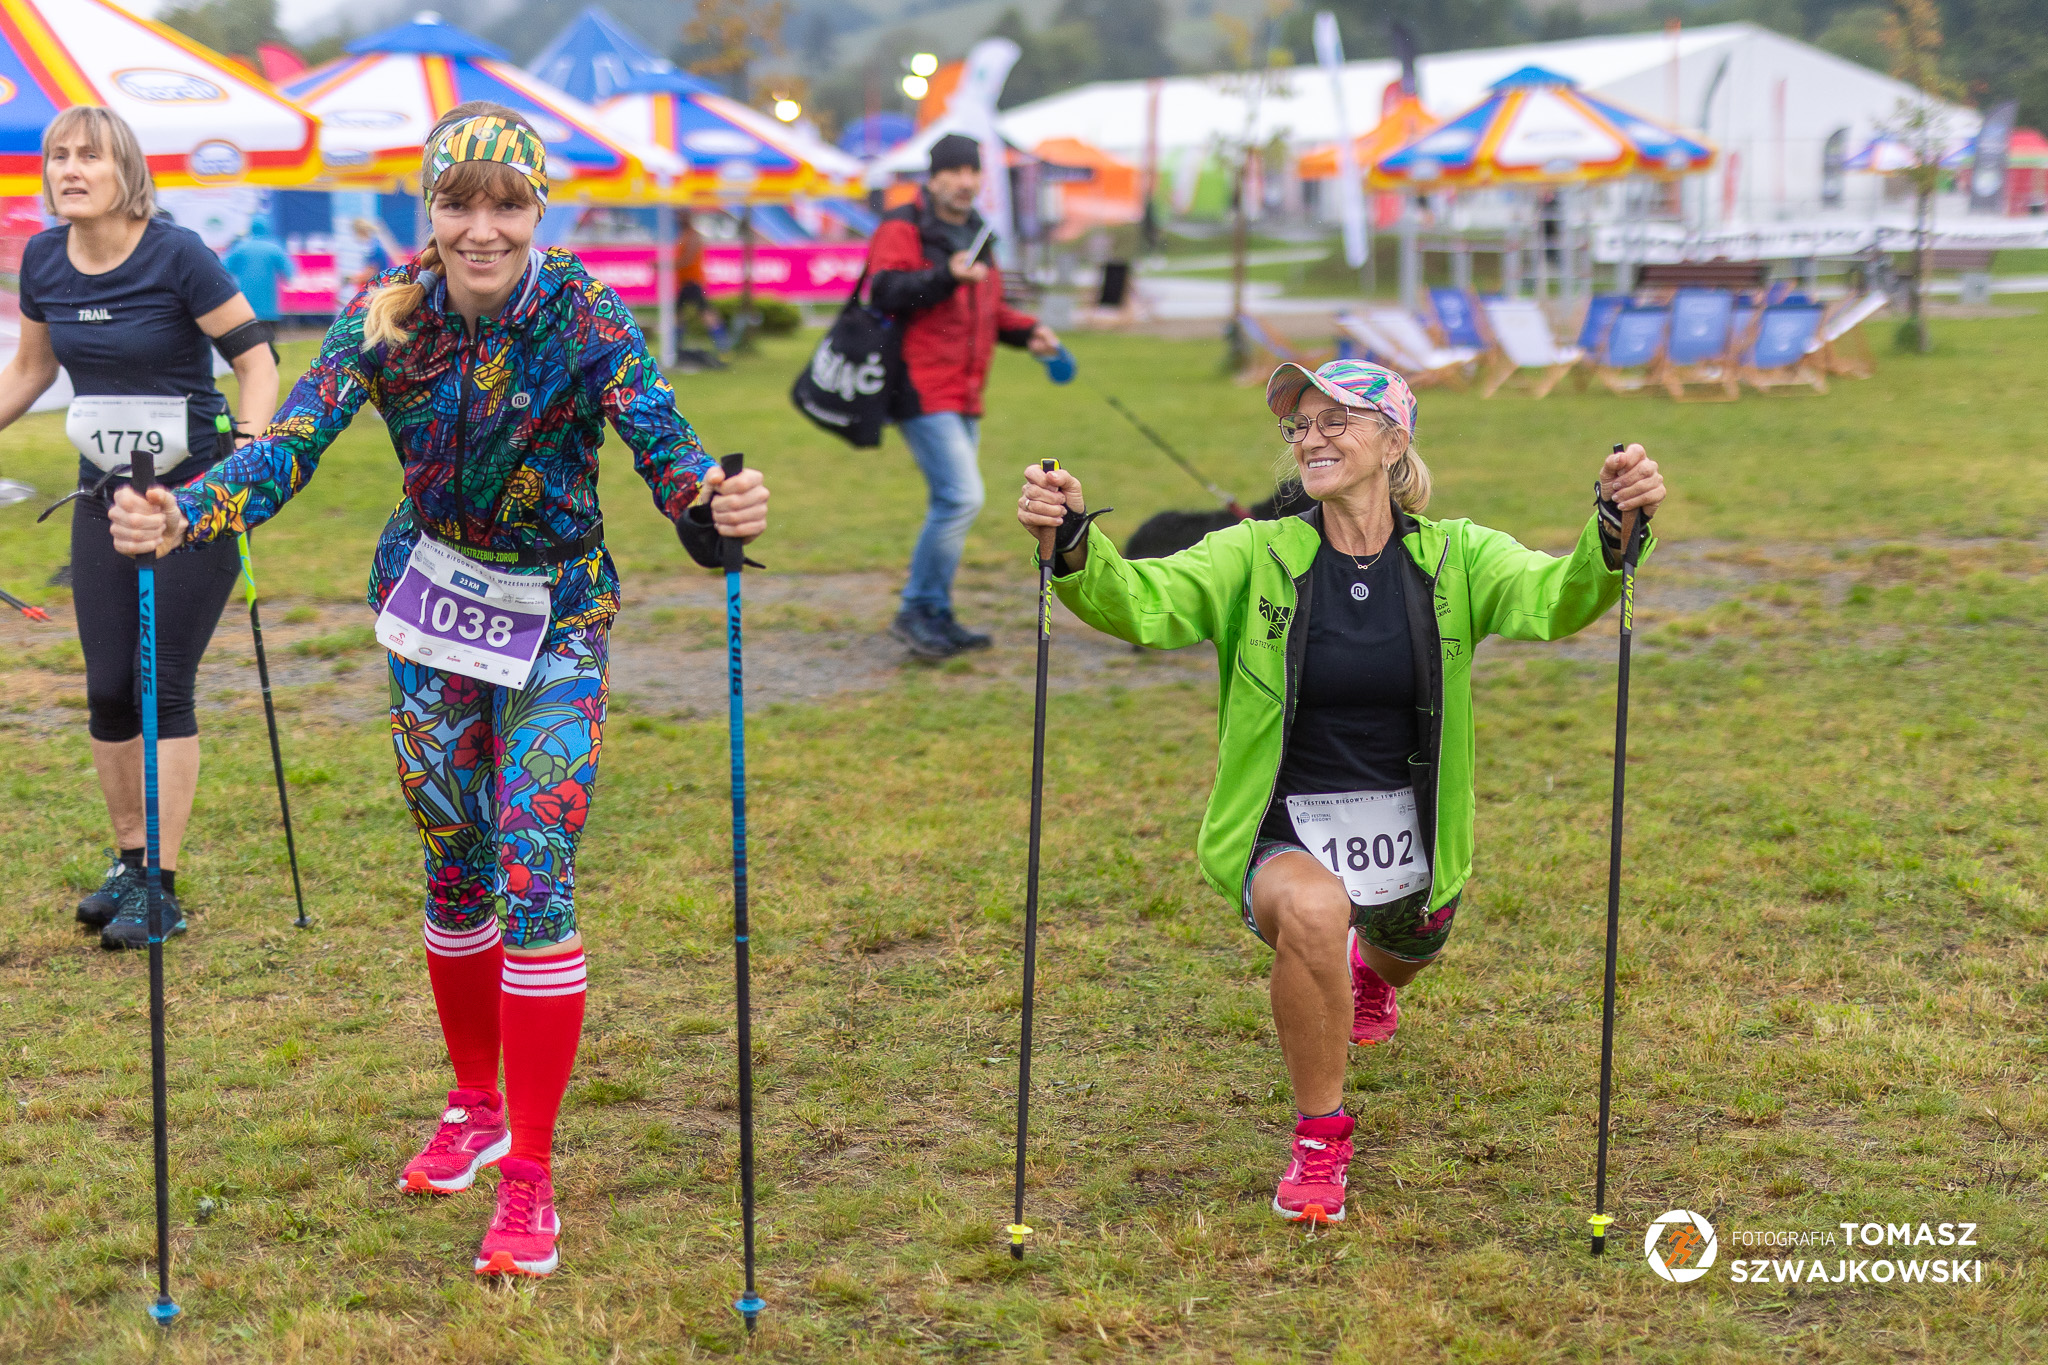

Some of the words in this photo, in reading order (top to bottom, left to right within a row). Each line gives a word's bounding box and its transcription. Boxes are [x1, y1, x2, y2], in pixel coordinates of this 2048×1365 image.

[78, 308, 112, 321] TRAIL
[91, 430, 163, 454] 1779
[446, 554, 474, 569] BIEGOWY
[497, 579, 529, 587] WRZEŚNIA
[460, 545, 519, 565] JASTRZĘBIU-ZDROJU
[459, 577, 468, 586] 23
[468, 581, 480, 591] KM
[419, 587, 514, 648] 1038
[1044, 579, 1053, 636] FIZAN
[1624, 574, 1634, 631] FIZAN
[140, 590, 152, 696] VIKING
[731, 592, 741, 696] VIKING
[1249, 638, 1279, 653] USTRZYKI
[1446, 643, 1463, 660] ĄŻ
[1322, 829, 1413, 872] 1802
